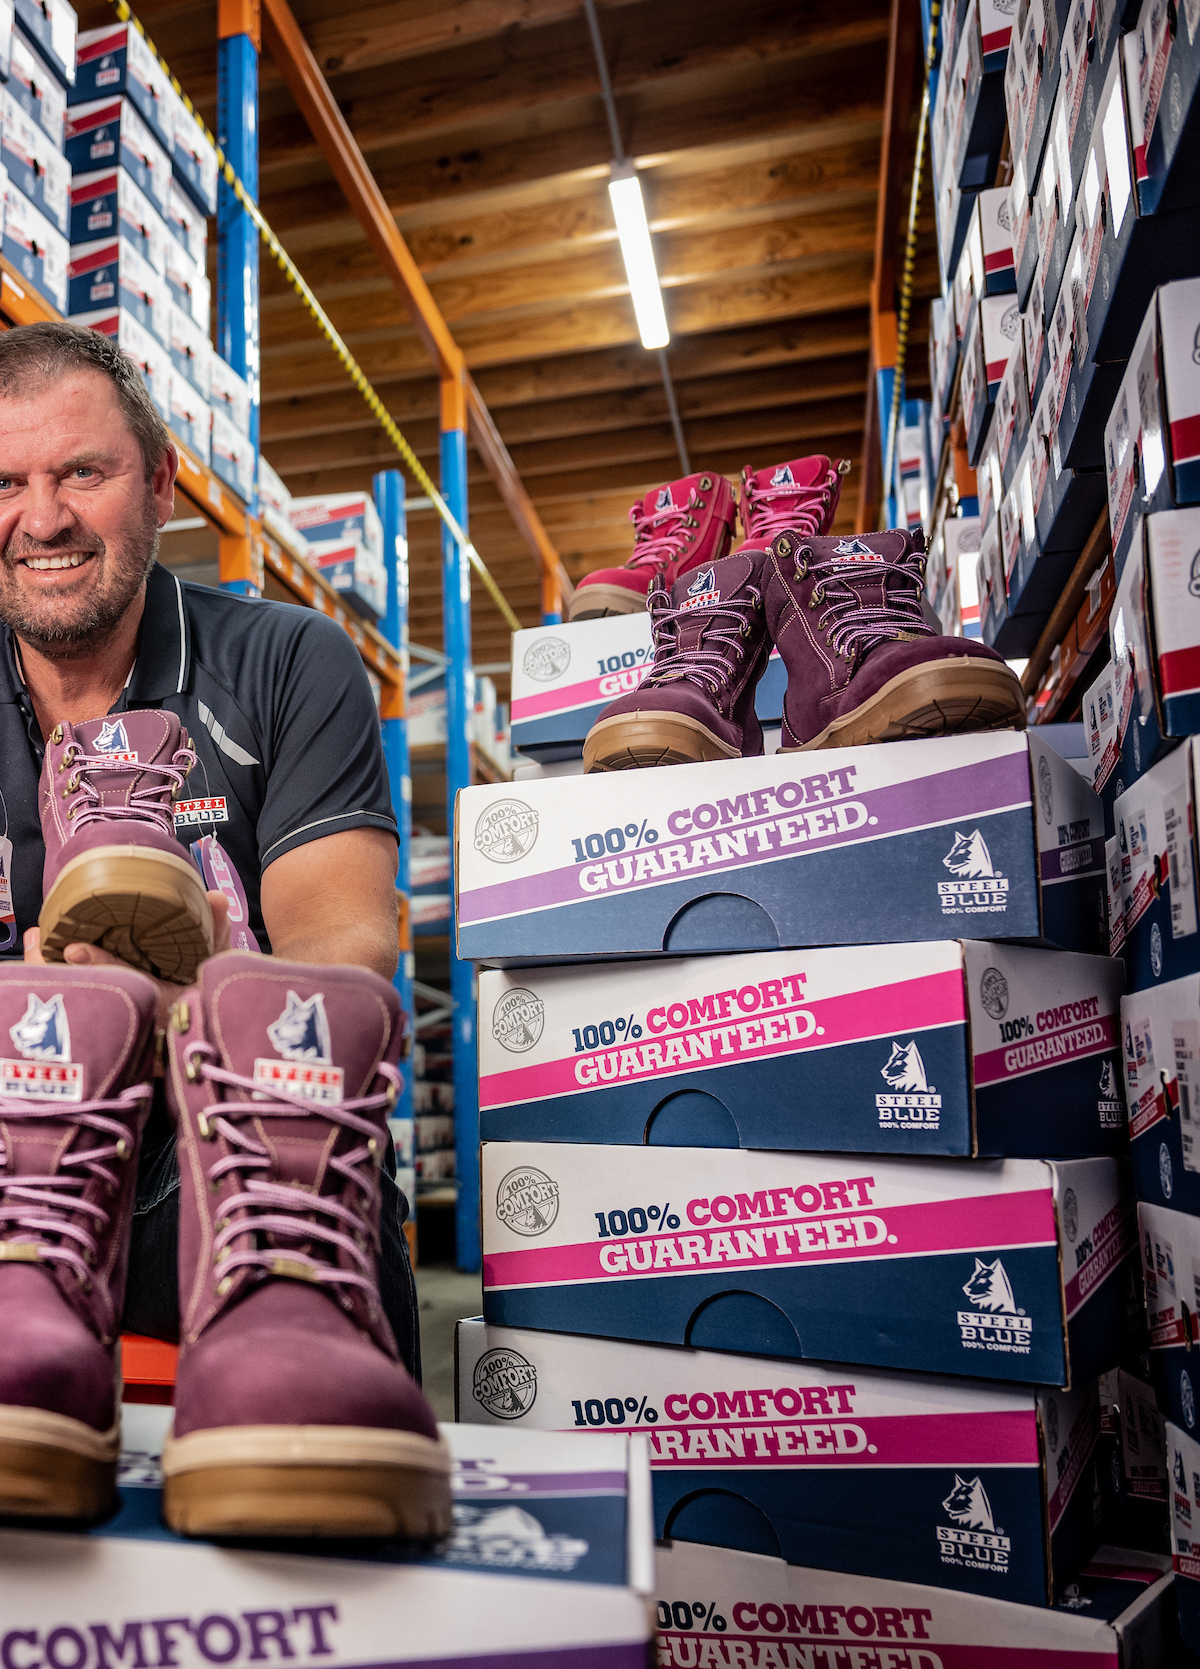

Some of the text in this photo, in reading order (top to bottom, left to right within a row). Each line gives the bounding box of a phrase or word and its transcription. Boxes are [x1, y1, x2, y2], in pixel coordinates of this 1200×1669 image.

[524, 644, 570, 673] COMFORT
[175, 799, 223, 813] STEEL
[485, 805, 517, 825] 100%
[571, 765, 857, 863] 100% COMFORT
[175, 810, 225, 824] BLUE
[473, 809, 540, 851] COMFORT
[579, 801, 878, 893] GUARANTEED.
[941, 880, 1006, 893] STEEL
[941, 893, 1007, 906] BLUE
[941, 906, 1007, 915] 100% COMFORT
[501, 994, 526, 1013] 100%
[572, 972, 807, 1053] 100% COMFORT
[492, 999, 545, 1041] COMFORT
[999, 997, 1099, 1044] 100% COMFORT
[574, 1009, 825, 1086] GUARANTEED.
[1004, 1023, 1107, 1072] GUARANTEED.
[4, 1063, 79, 1081] STEEL
[878, 1094, 939, 1106] STEEL
[1098, 1103, 1123, 1111] STEEL
[878, 1108, 940, 1121] BLUE
[1100, 1111, 1123, 1122] BLUE
[900, 1121, 940, 1130] COMFORT
[506, 1174, 537, 1195] 100%
[496, 1181, 559, 1222] COMFORT
[595, 1177, 875, 1238] 100% COMFORT
[599, 1216, 898, 1274] GUARANTEED.
[961, 1314, 1028, 1328] STEEL
[961, 1326, 1030, 1345] BLUE
[962, 1341, 1030, 1354] 100% COMFORT
[483, 1357, 514, 1377] 100%
[472, 1364, 537, 1401] COMFORT
[572, 1385, 856, 1426] 100% COMFORT
[648, 1423, 878, 1459] ARANTEED.
[939, 1528, 1008, 1549] STEEL
[940, 1542, 1009, 1564] BLUE
[940, 1556, 1009, 1573] 100% COMFORT
[655, 1601, 933, 1639] 00% COMFORT
[0, 1603, 340, 1669] COMFORT
